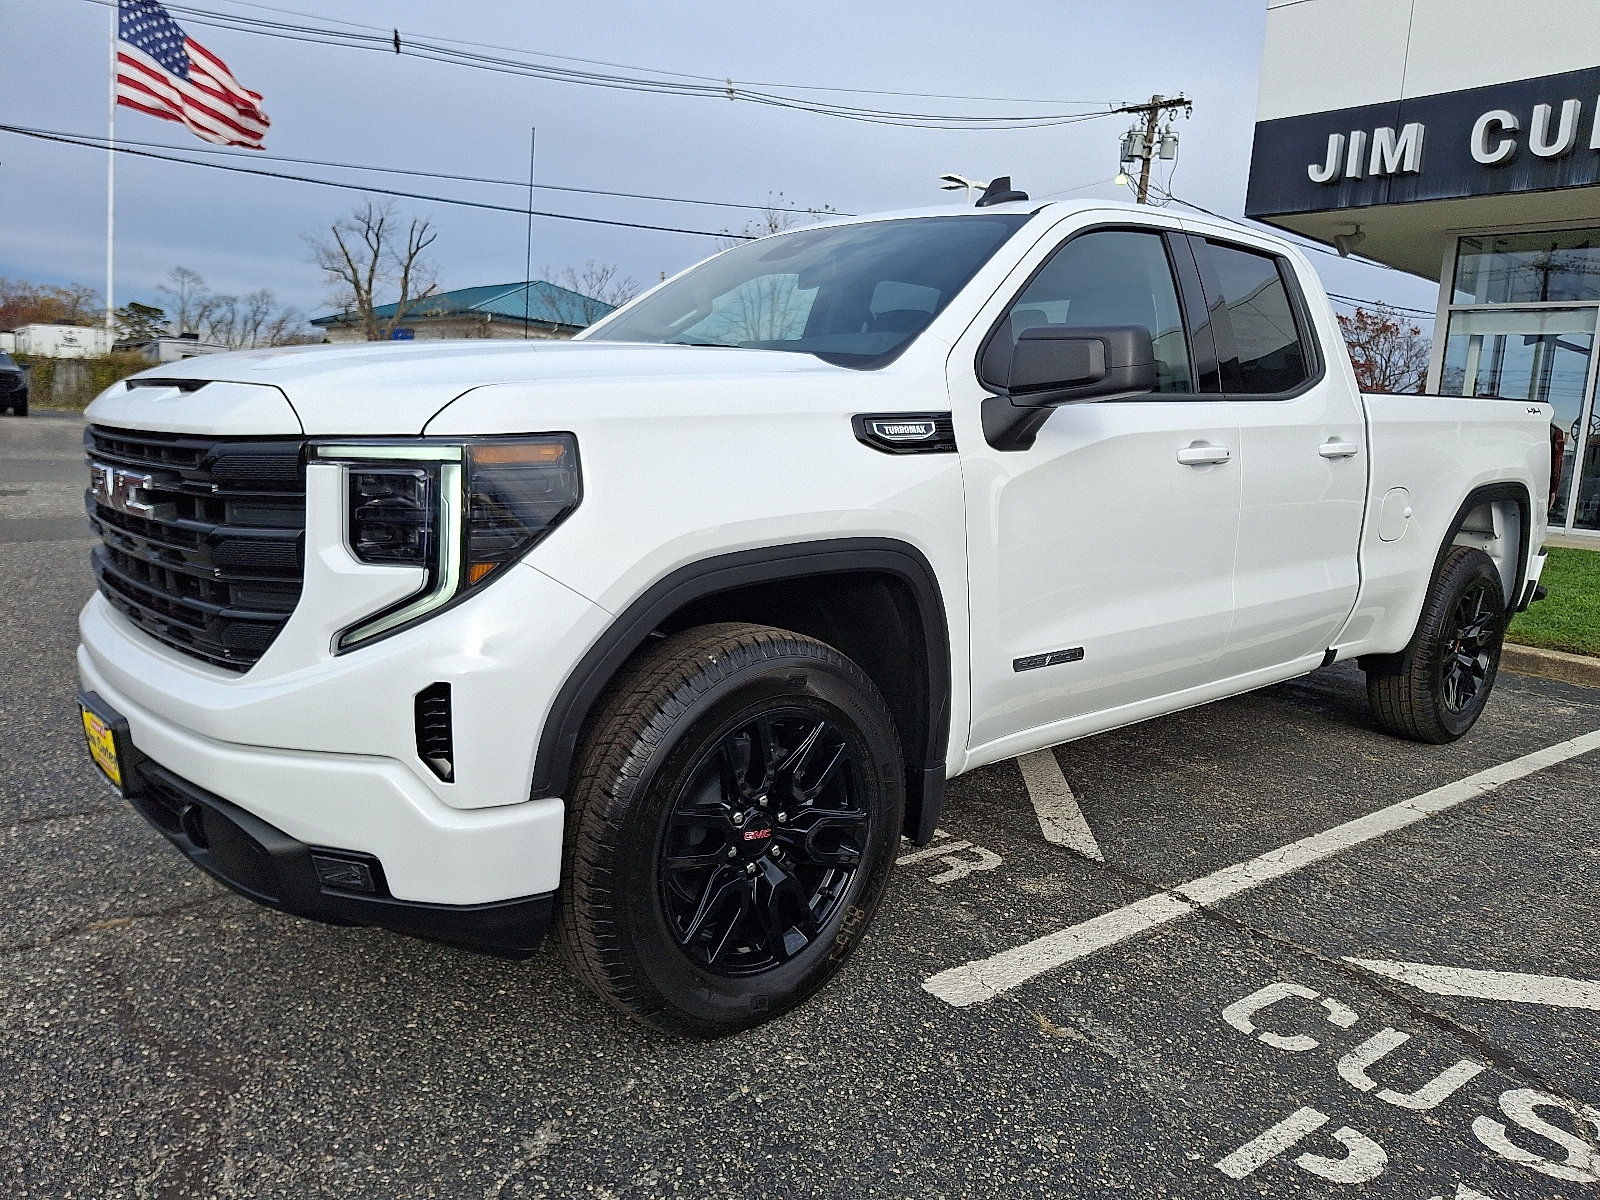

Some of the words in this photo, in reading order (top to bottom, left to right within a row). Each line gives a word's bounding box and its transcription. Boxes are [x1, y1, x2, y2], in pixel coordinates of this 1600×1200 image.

[1307, 122, 1425, 184] JIM
[1470, 95, 1600, 166] CU
[883, 425, 927, 435] TURBOMAX
[743, 829, 772, 841] GMC
